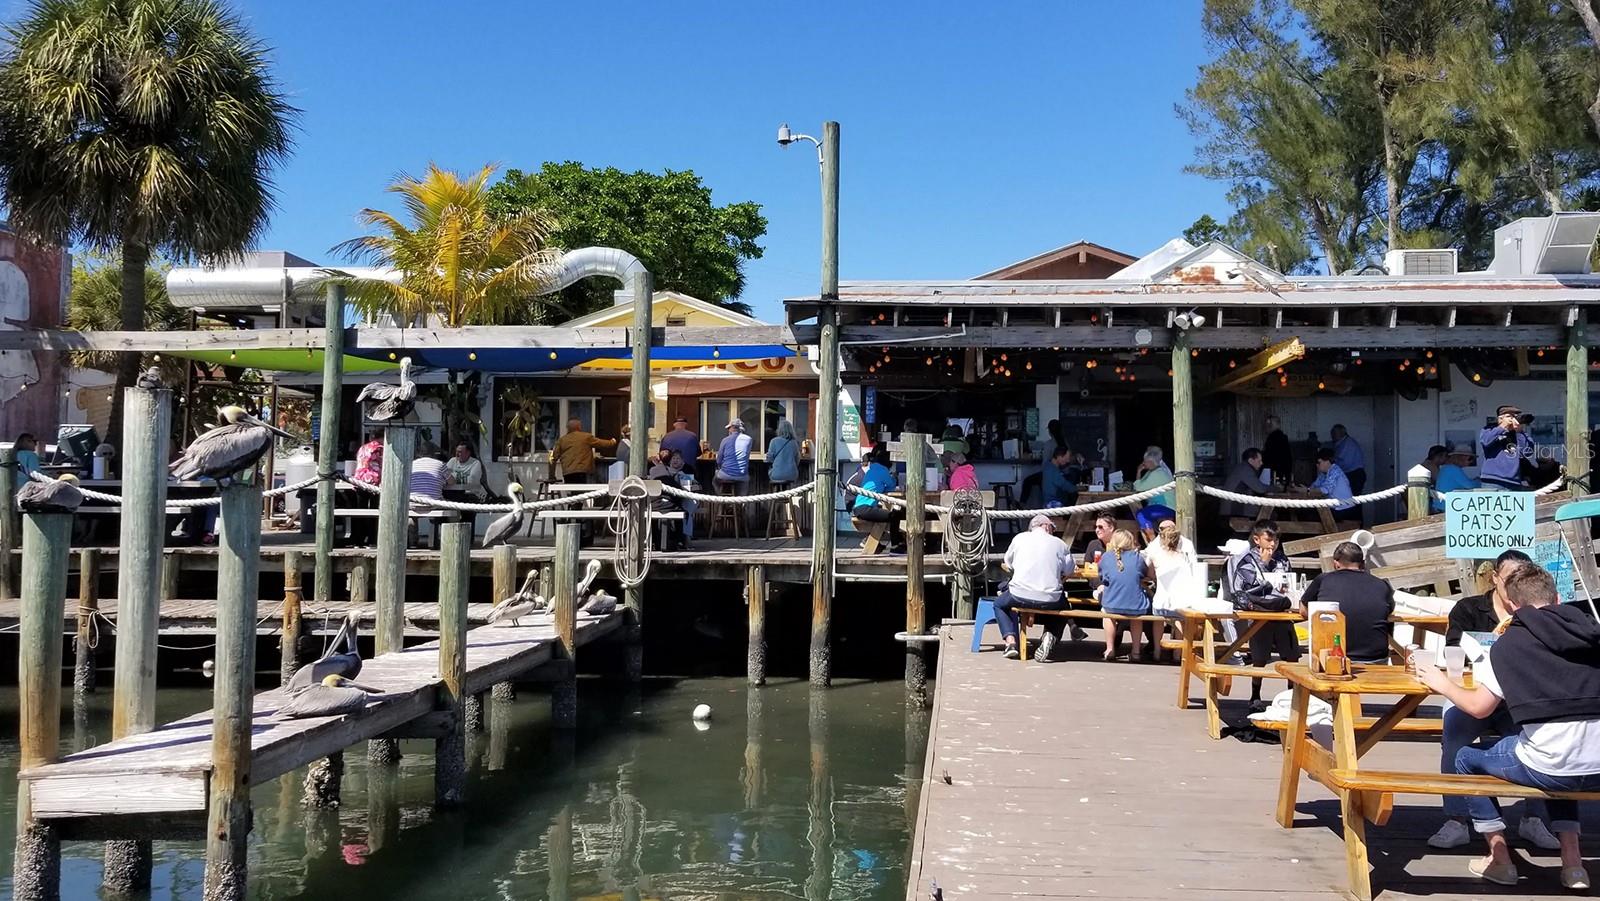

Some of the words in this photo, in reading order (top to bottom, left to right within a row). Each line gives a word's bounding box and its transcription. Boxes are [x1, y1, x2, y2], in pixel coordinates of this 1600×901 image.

[1451, 495, 1525, 512] CAPTAIN
[1461, 513, 1517, 531] PATSY
[1448, 533, 1505, 548] DOCKING
[1506, 534, 1534, 548] ONLY
